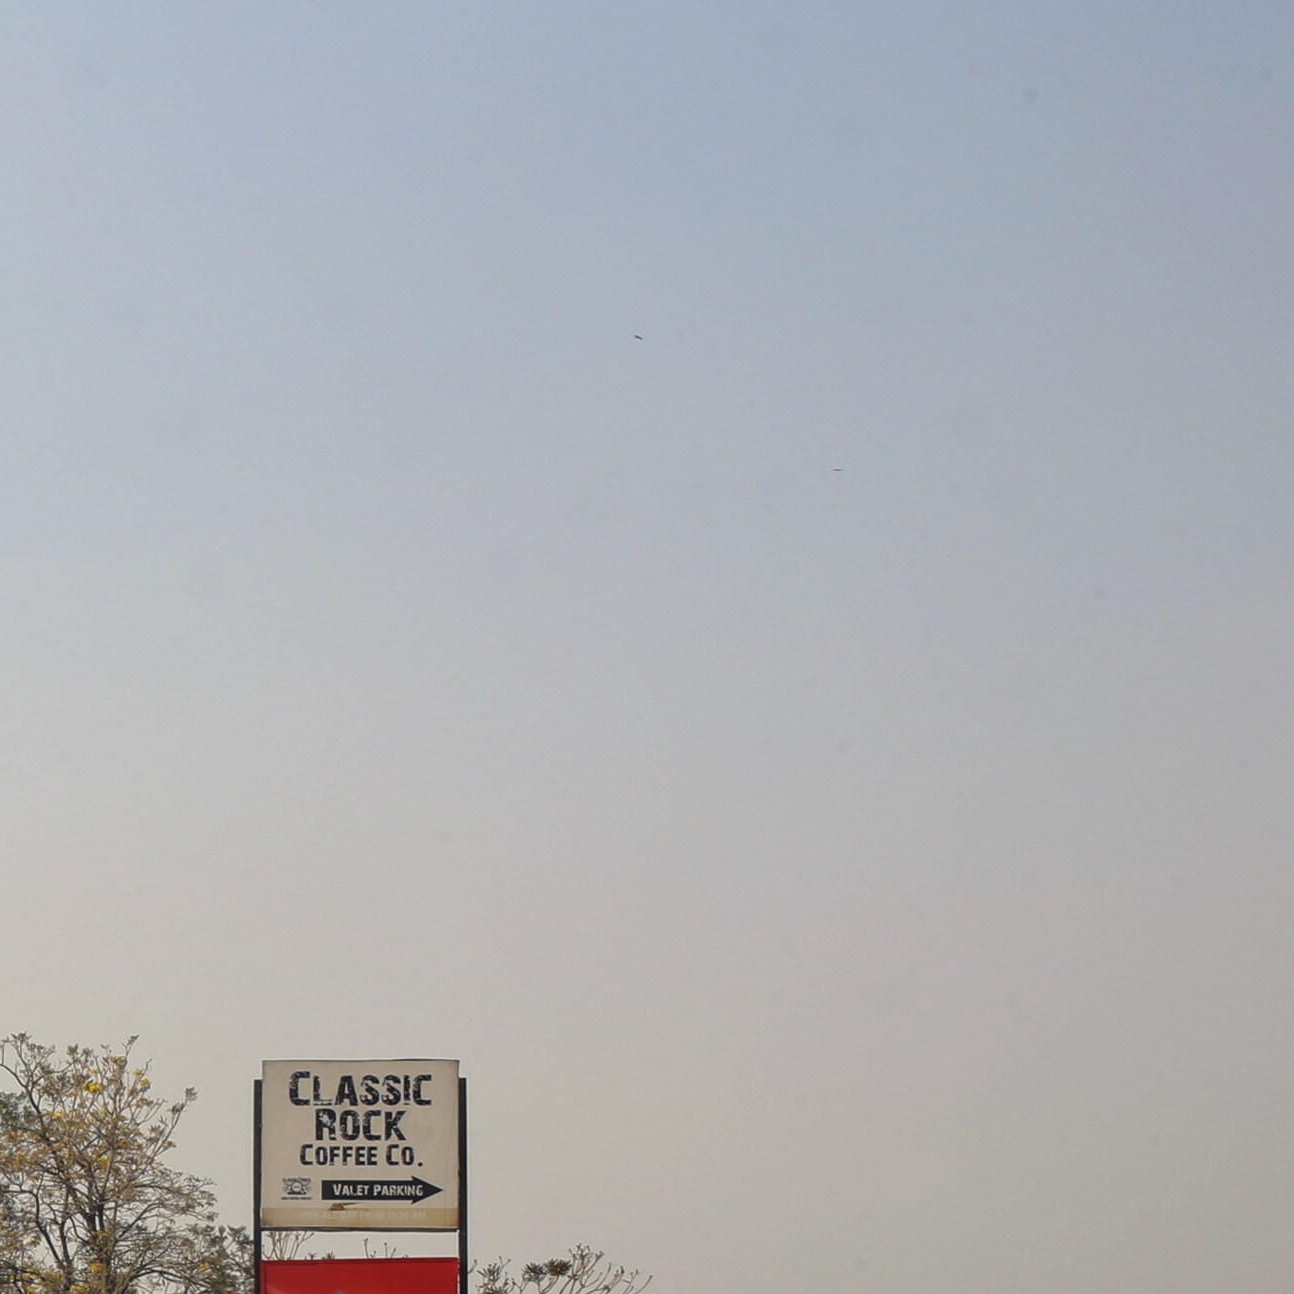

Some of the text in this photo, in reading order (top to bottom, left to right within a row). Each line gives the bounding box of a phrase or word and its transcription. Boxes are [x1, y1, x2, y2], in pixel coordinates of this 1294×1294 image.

[289, 1071, 432, 1106] CLASSIC
[315, 1108, 407, 1141] ROCK
[299, 1144, 423, 1167] COFFEE CO.
[333, 1184, 423, 1196] VALET PARKING
